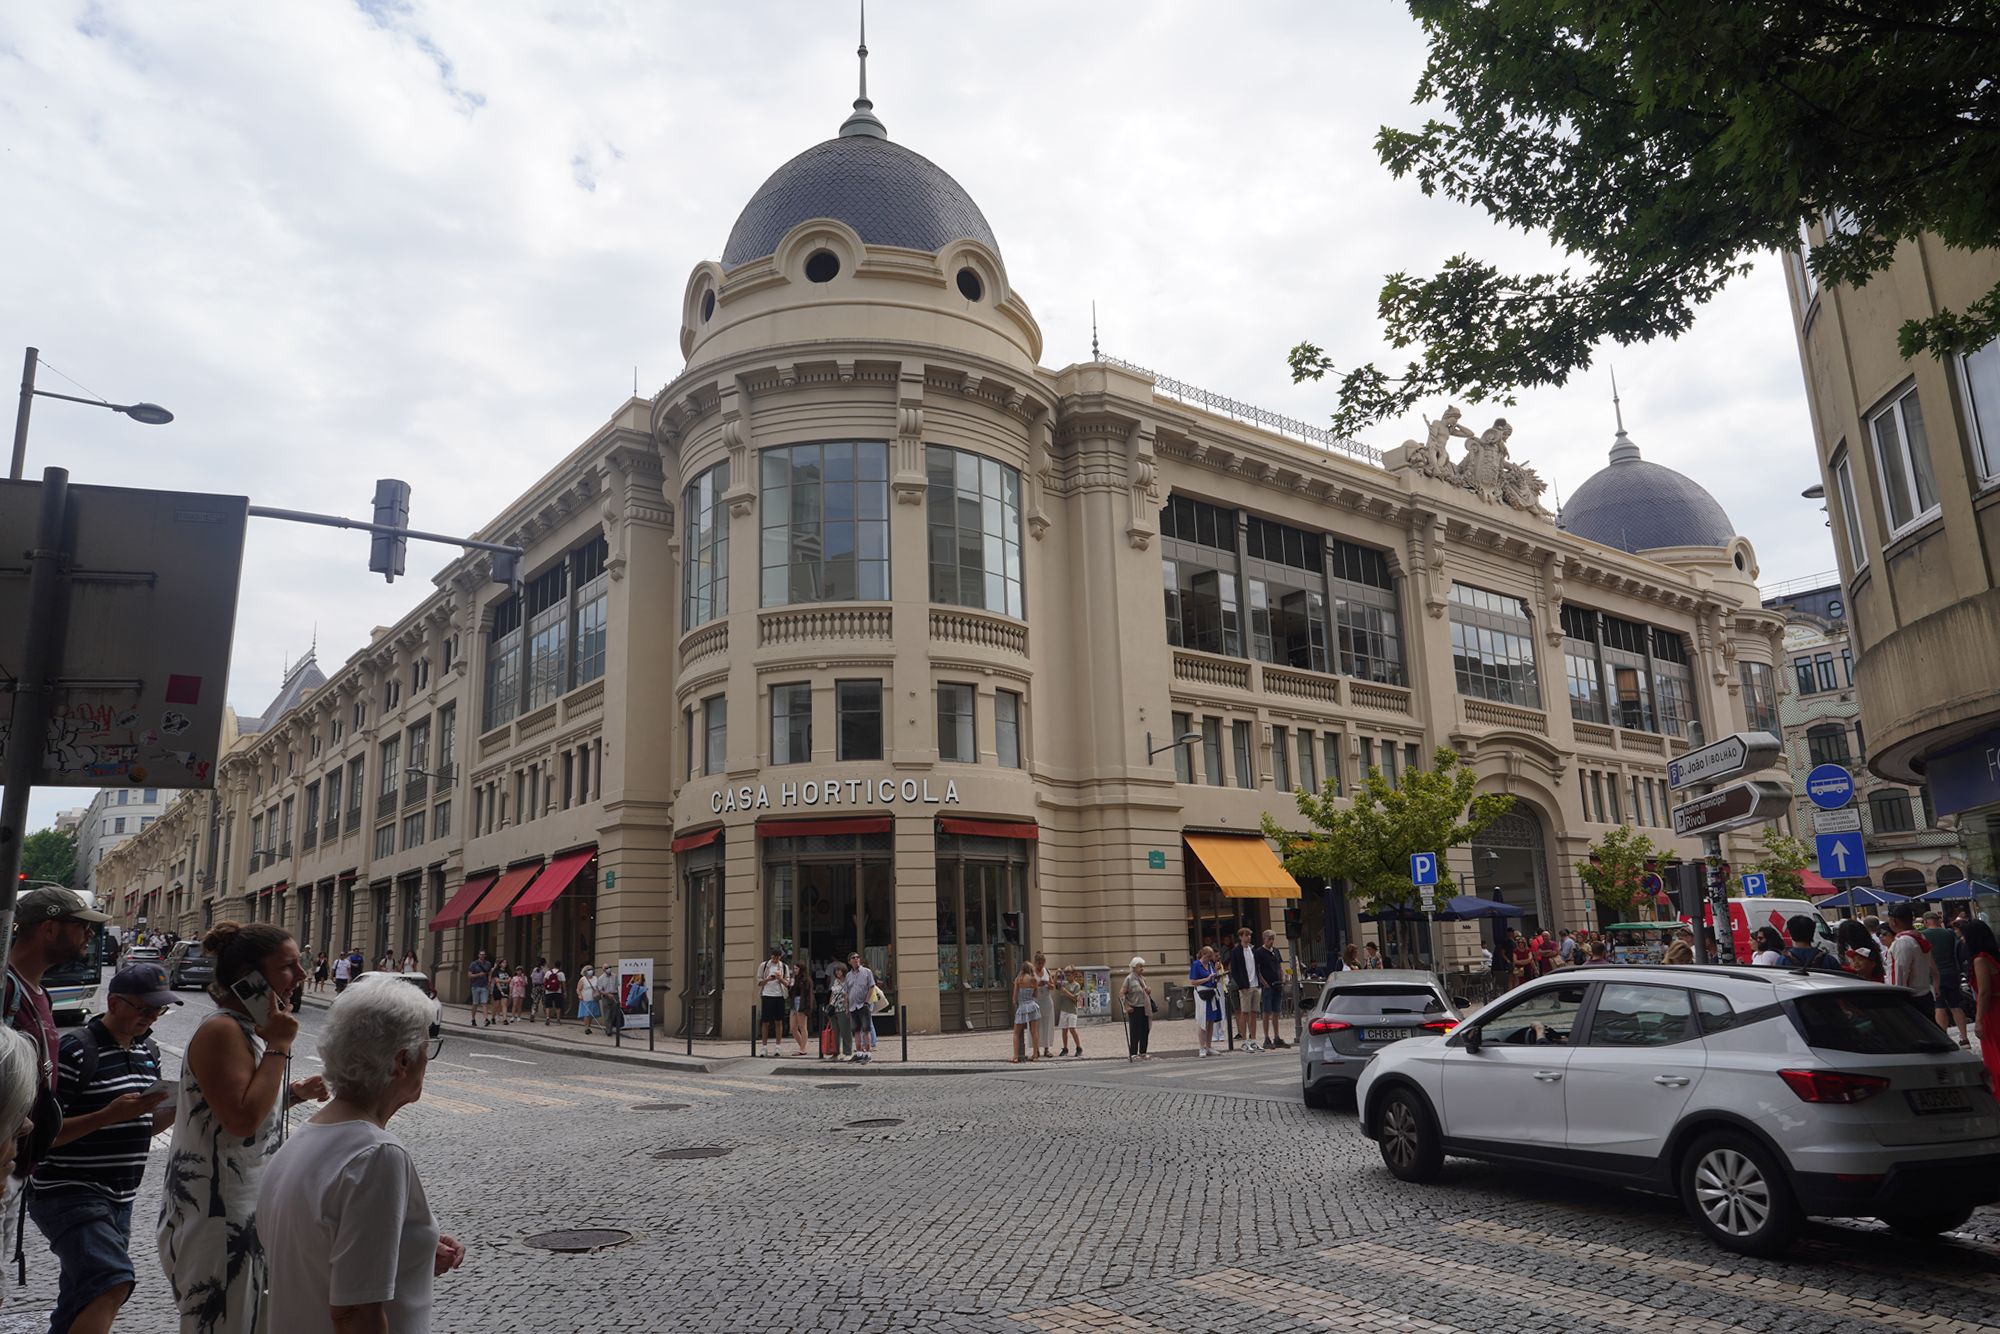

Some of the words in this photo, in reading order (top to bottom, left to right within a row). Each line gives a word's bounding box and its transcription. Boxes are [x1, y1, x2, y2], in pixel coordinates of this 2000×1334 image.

[1679, 765, 1687, 777] D.
[1688, 758, 1705, 775] João
[711, 785, 770, 814] CASA
[781, 778, 960, 807] HORTICOLA
[1685, 811, 1707, 829] Rivoli
[1416, 856, 1431, 882] P
[1747, 877, 1760, 894] P
[1368, 1029, 1407, 1039] CH83LE
